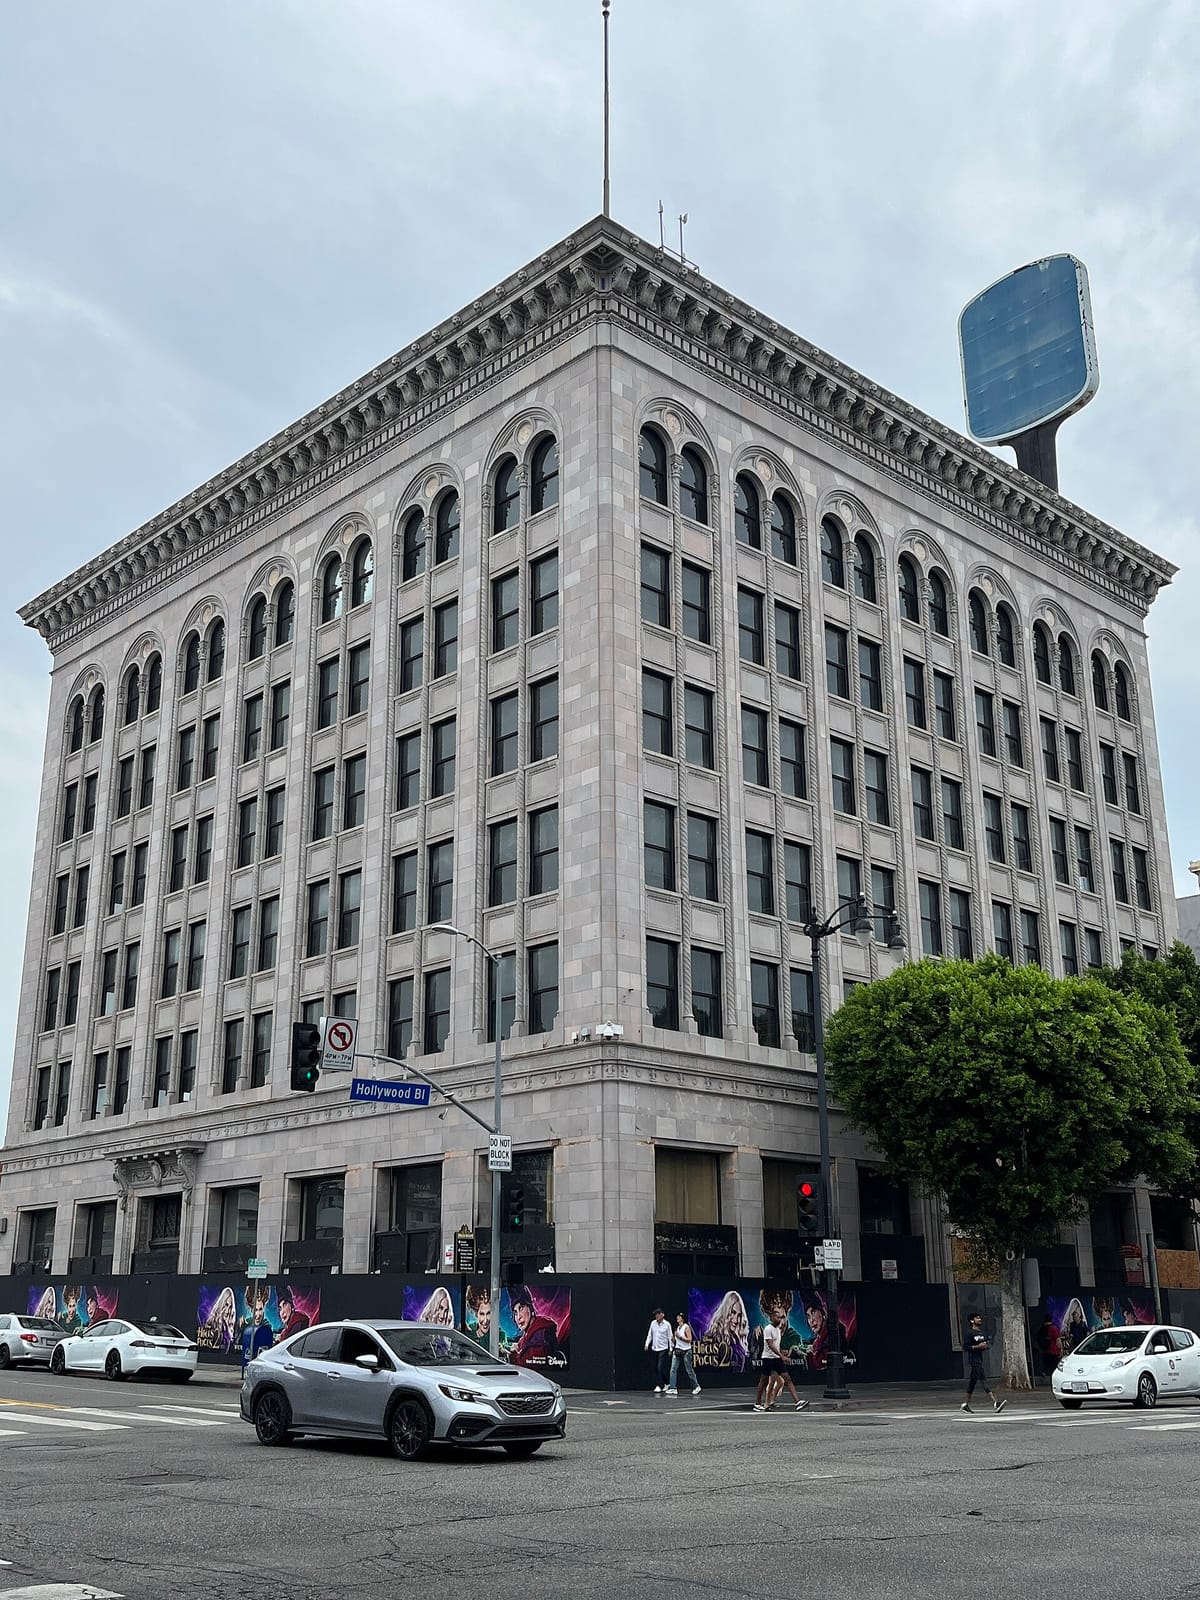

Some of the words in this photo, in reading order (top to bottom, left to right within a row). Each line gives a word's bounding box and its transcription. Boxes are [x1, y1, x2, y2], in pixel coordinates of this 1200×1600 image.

[356, 1083, 411, 1100] Hollywood
[414, 1088, 426, 1100] Bl
[490, 1138, 498, 1147] DO
[500, 1138, 511, 1148] NOT
[490, 1150, 510, 1160] BLOCK
